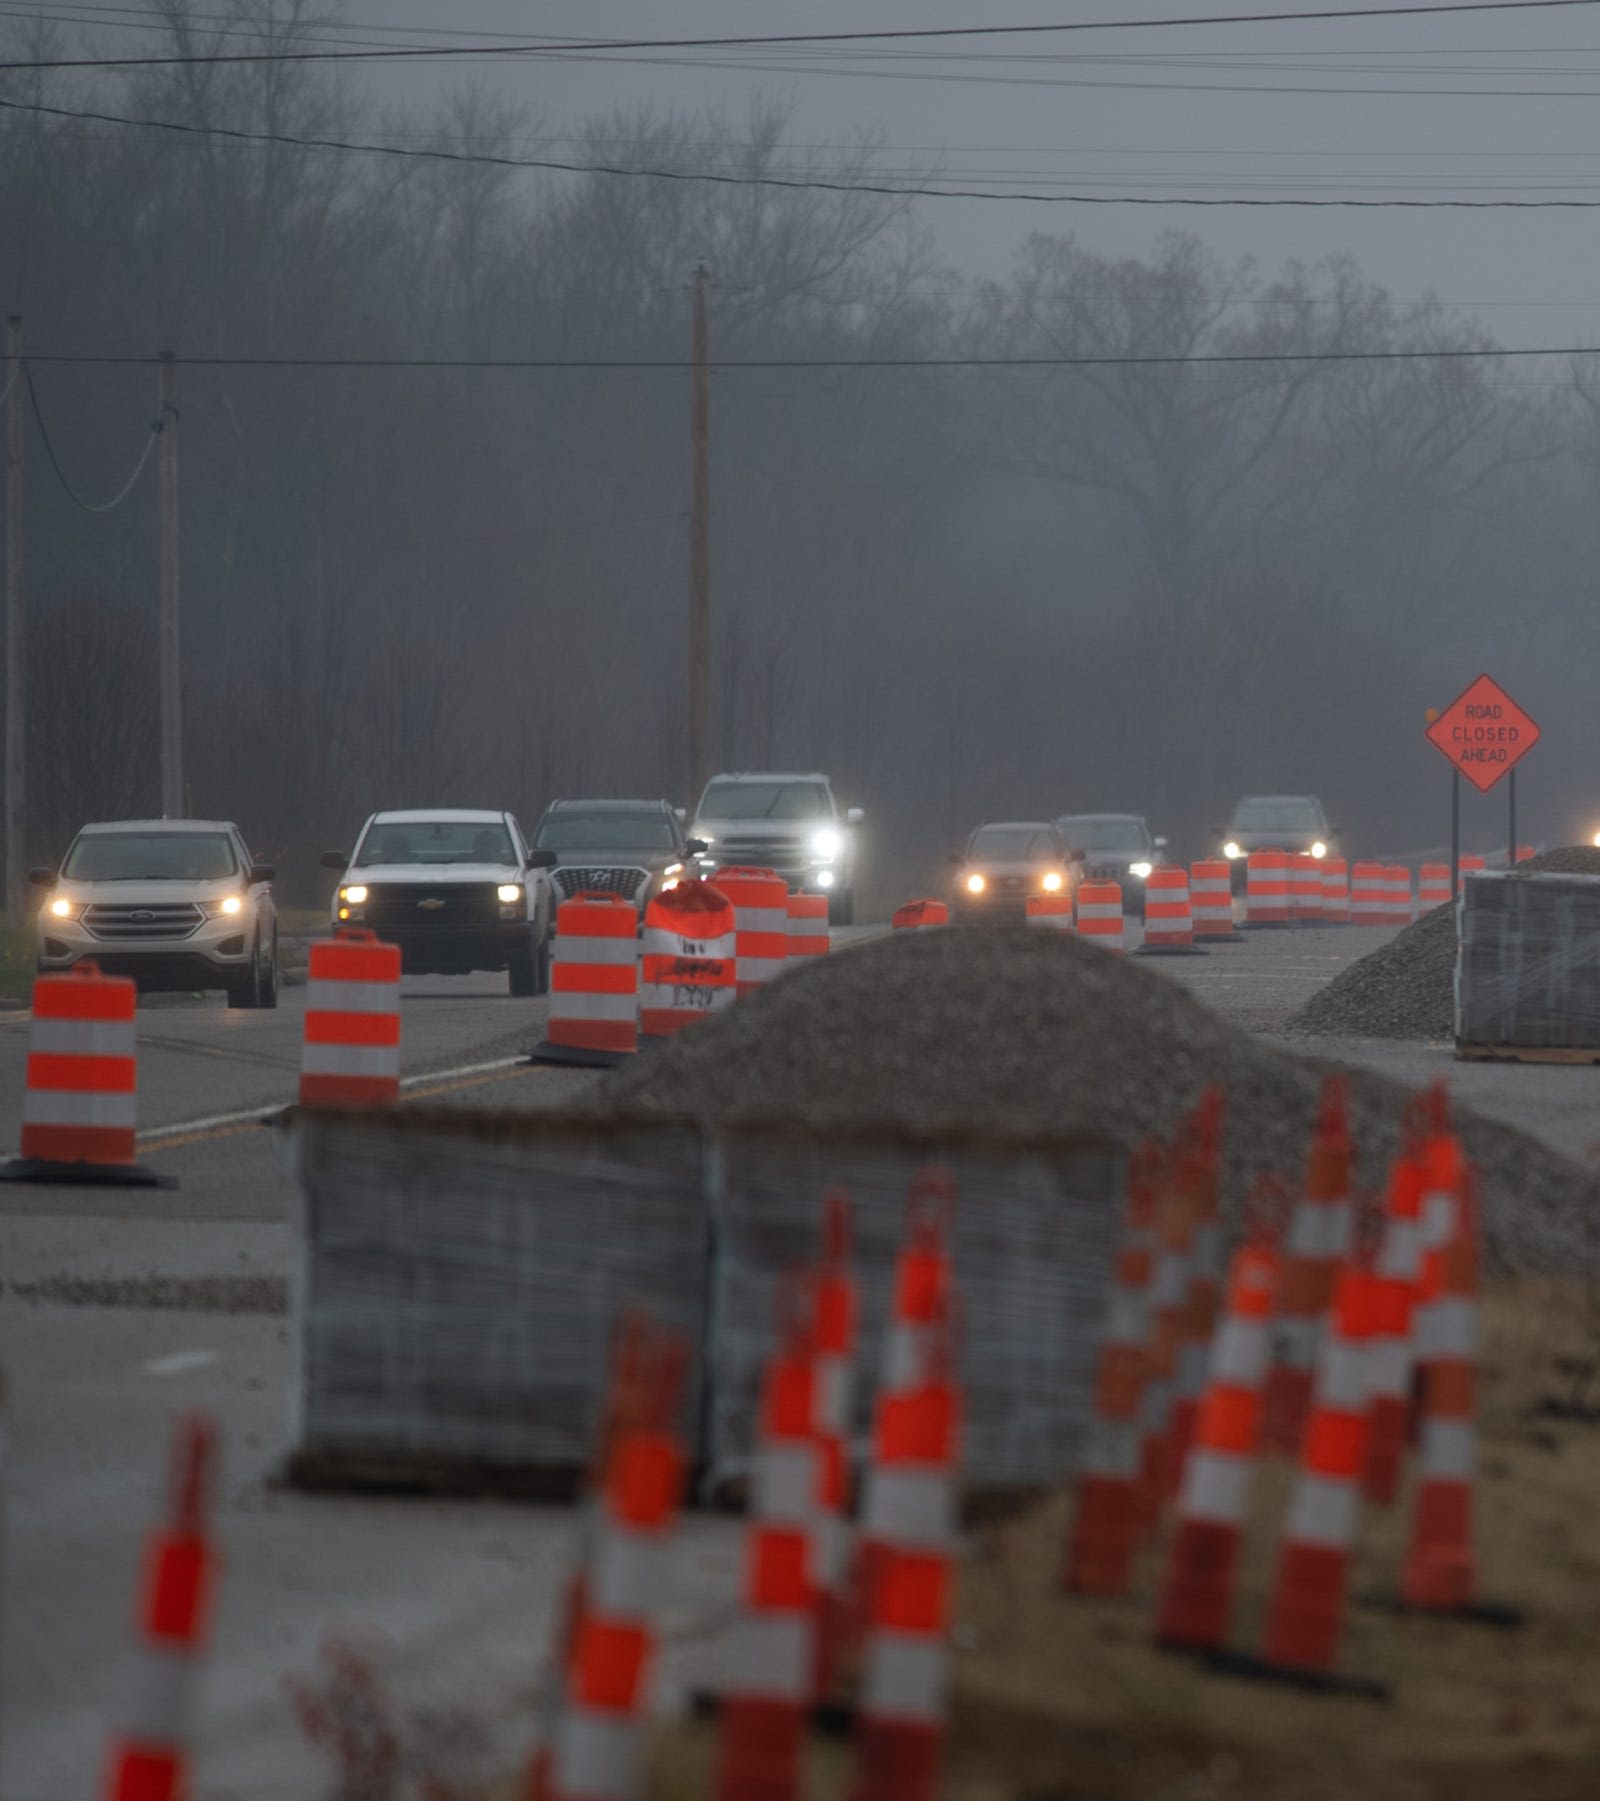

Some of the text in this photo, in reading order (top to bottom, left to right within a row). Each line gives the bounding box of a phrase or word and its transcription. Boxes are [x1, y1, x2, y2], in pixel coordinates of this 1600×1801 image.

[1465, 704, 1503, 719] ROAD
[1452, 726, 1519, 741] CLOSED
[1460, 748, 1508, 763] AHEAD
